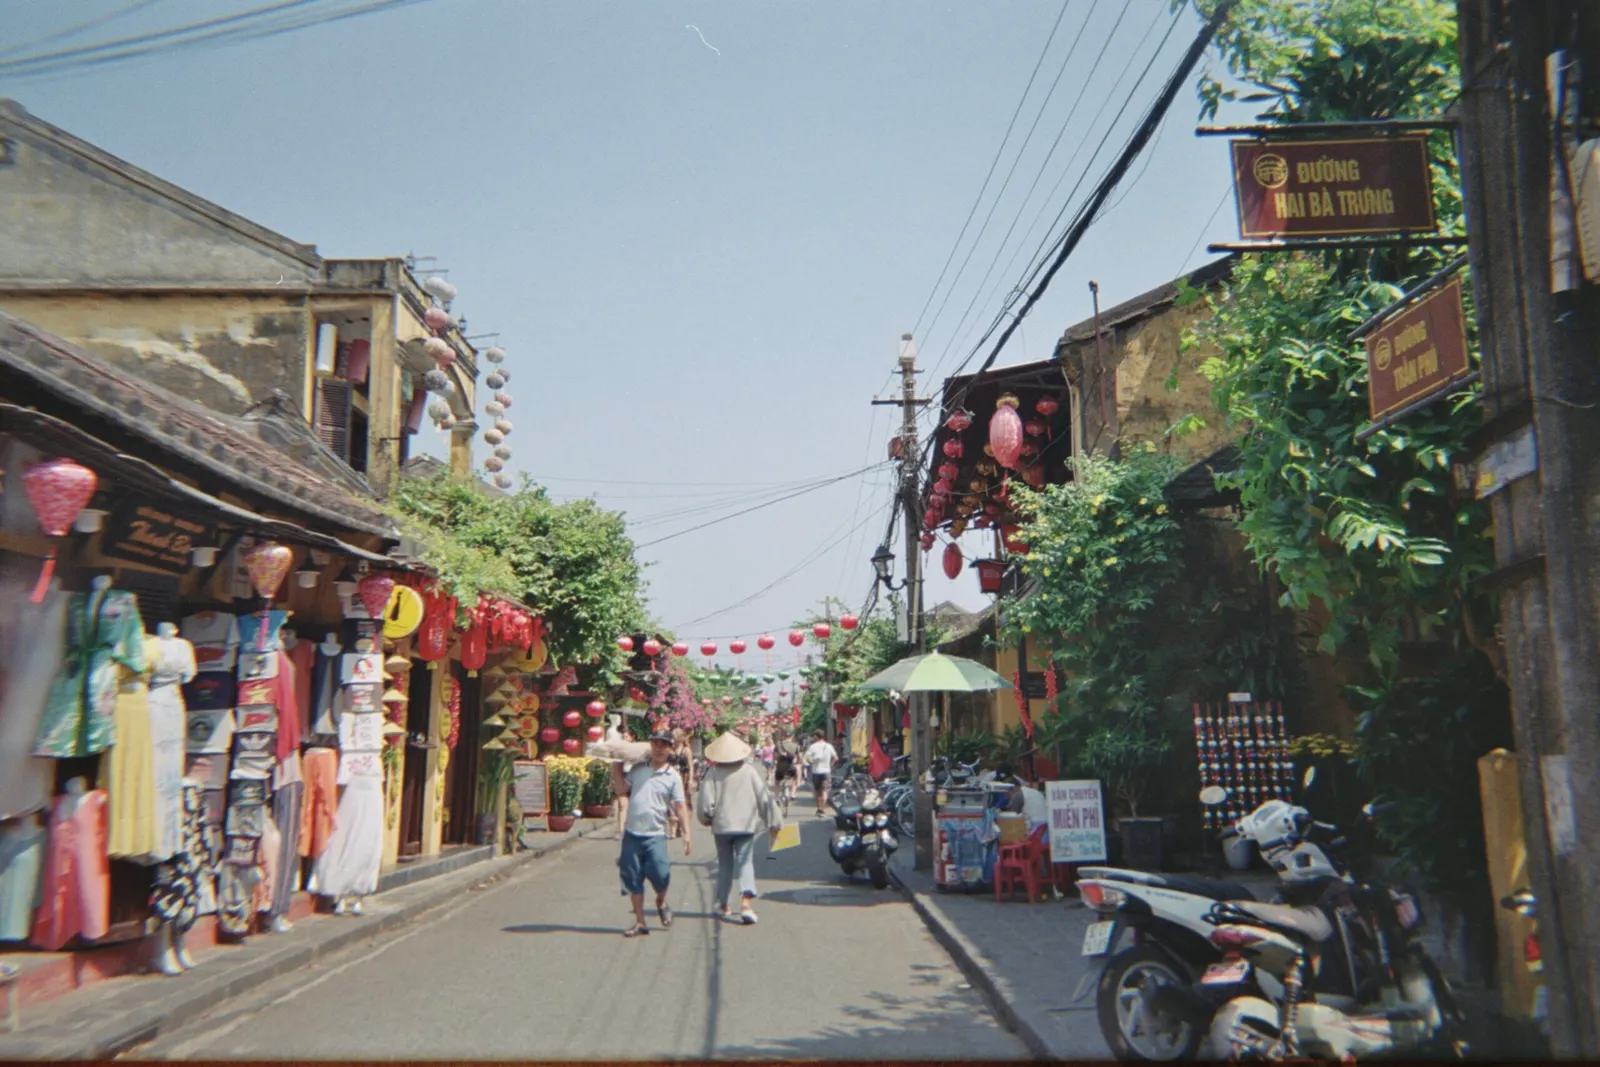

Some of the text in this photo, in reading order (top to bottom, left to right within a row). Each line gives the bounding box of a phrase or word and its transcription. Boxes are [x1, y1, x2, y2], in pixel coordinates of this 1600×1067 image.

[1297, 155, 1360, 183] ĐƯỜNG
[1275, 186, 1394, 218] HAI BÀ TRƯNG
